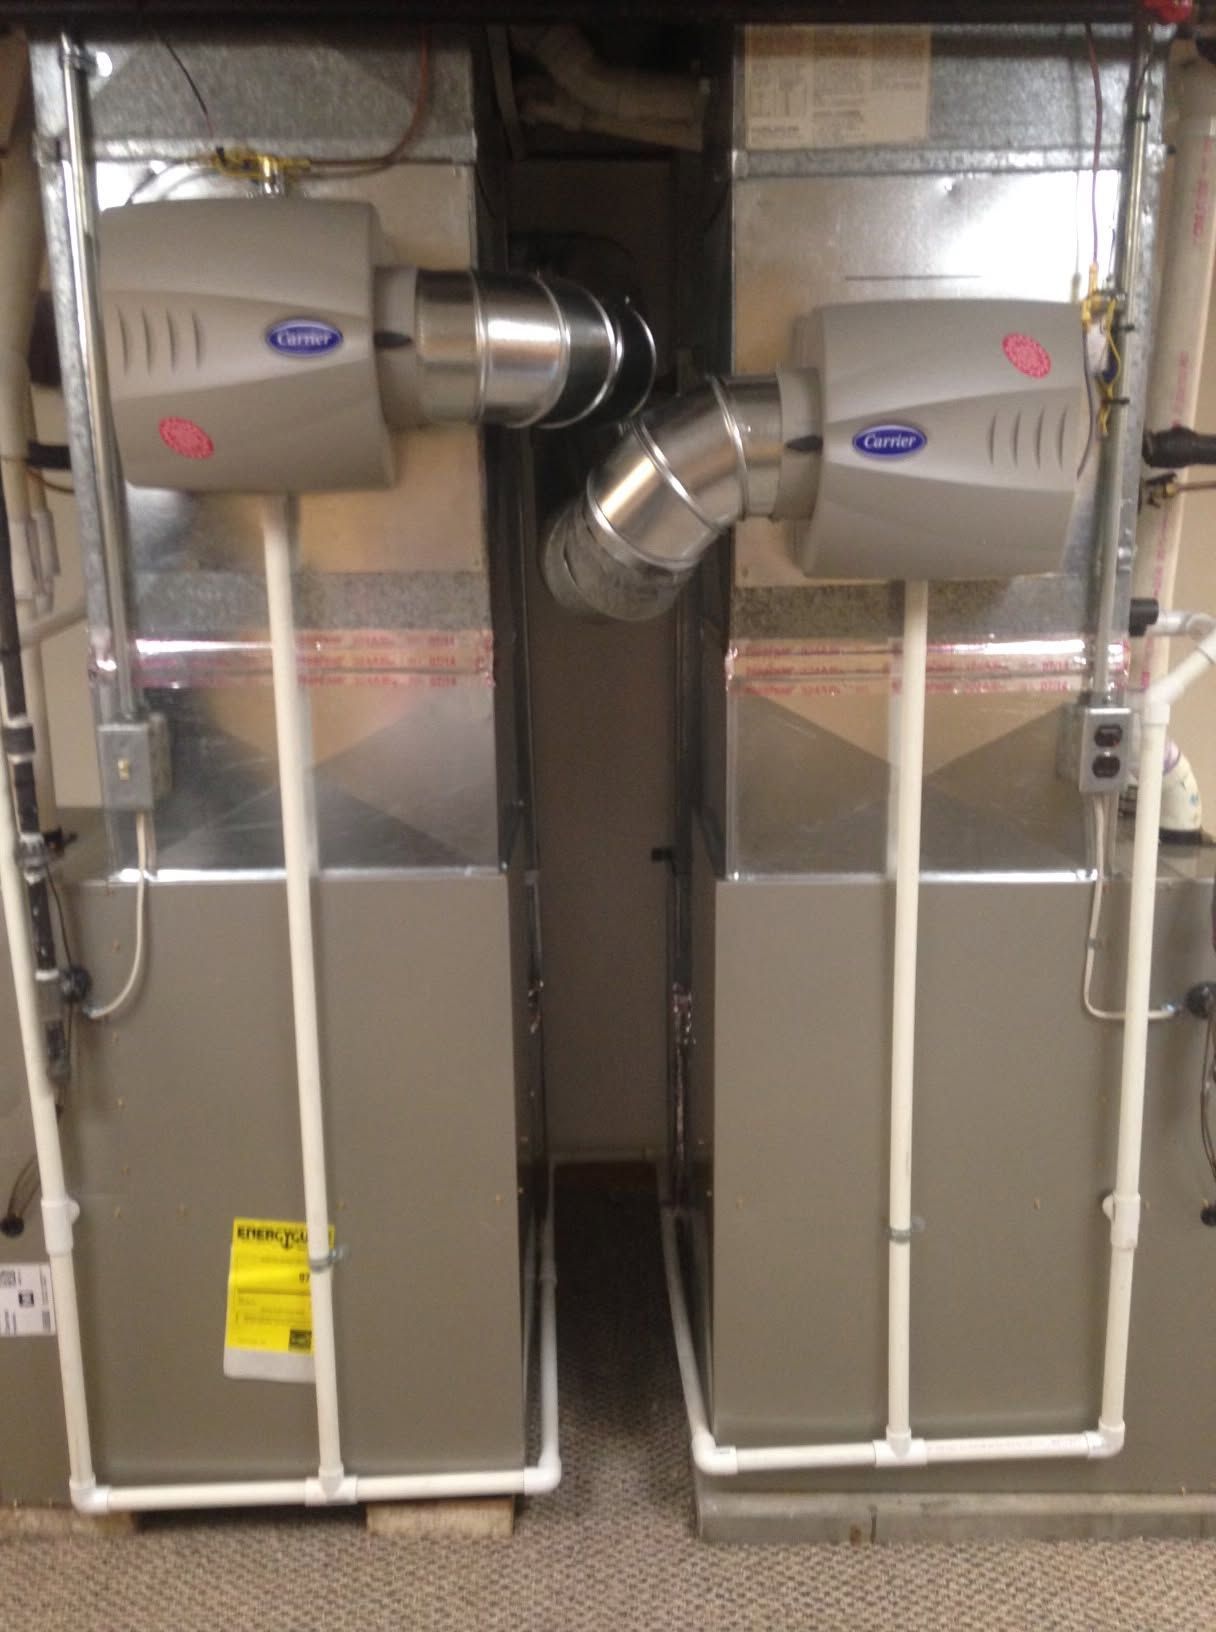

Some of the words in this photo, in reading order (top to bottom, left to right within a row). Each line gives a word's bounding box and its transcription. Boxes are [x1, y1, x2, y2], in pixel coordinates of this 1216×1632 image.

[276, 331, 330, 346] Carrier
[864, 433, 917, 449] Carrier
[237, 1225, 333, 1249] ENERGYGU
